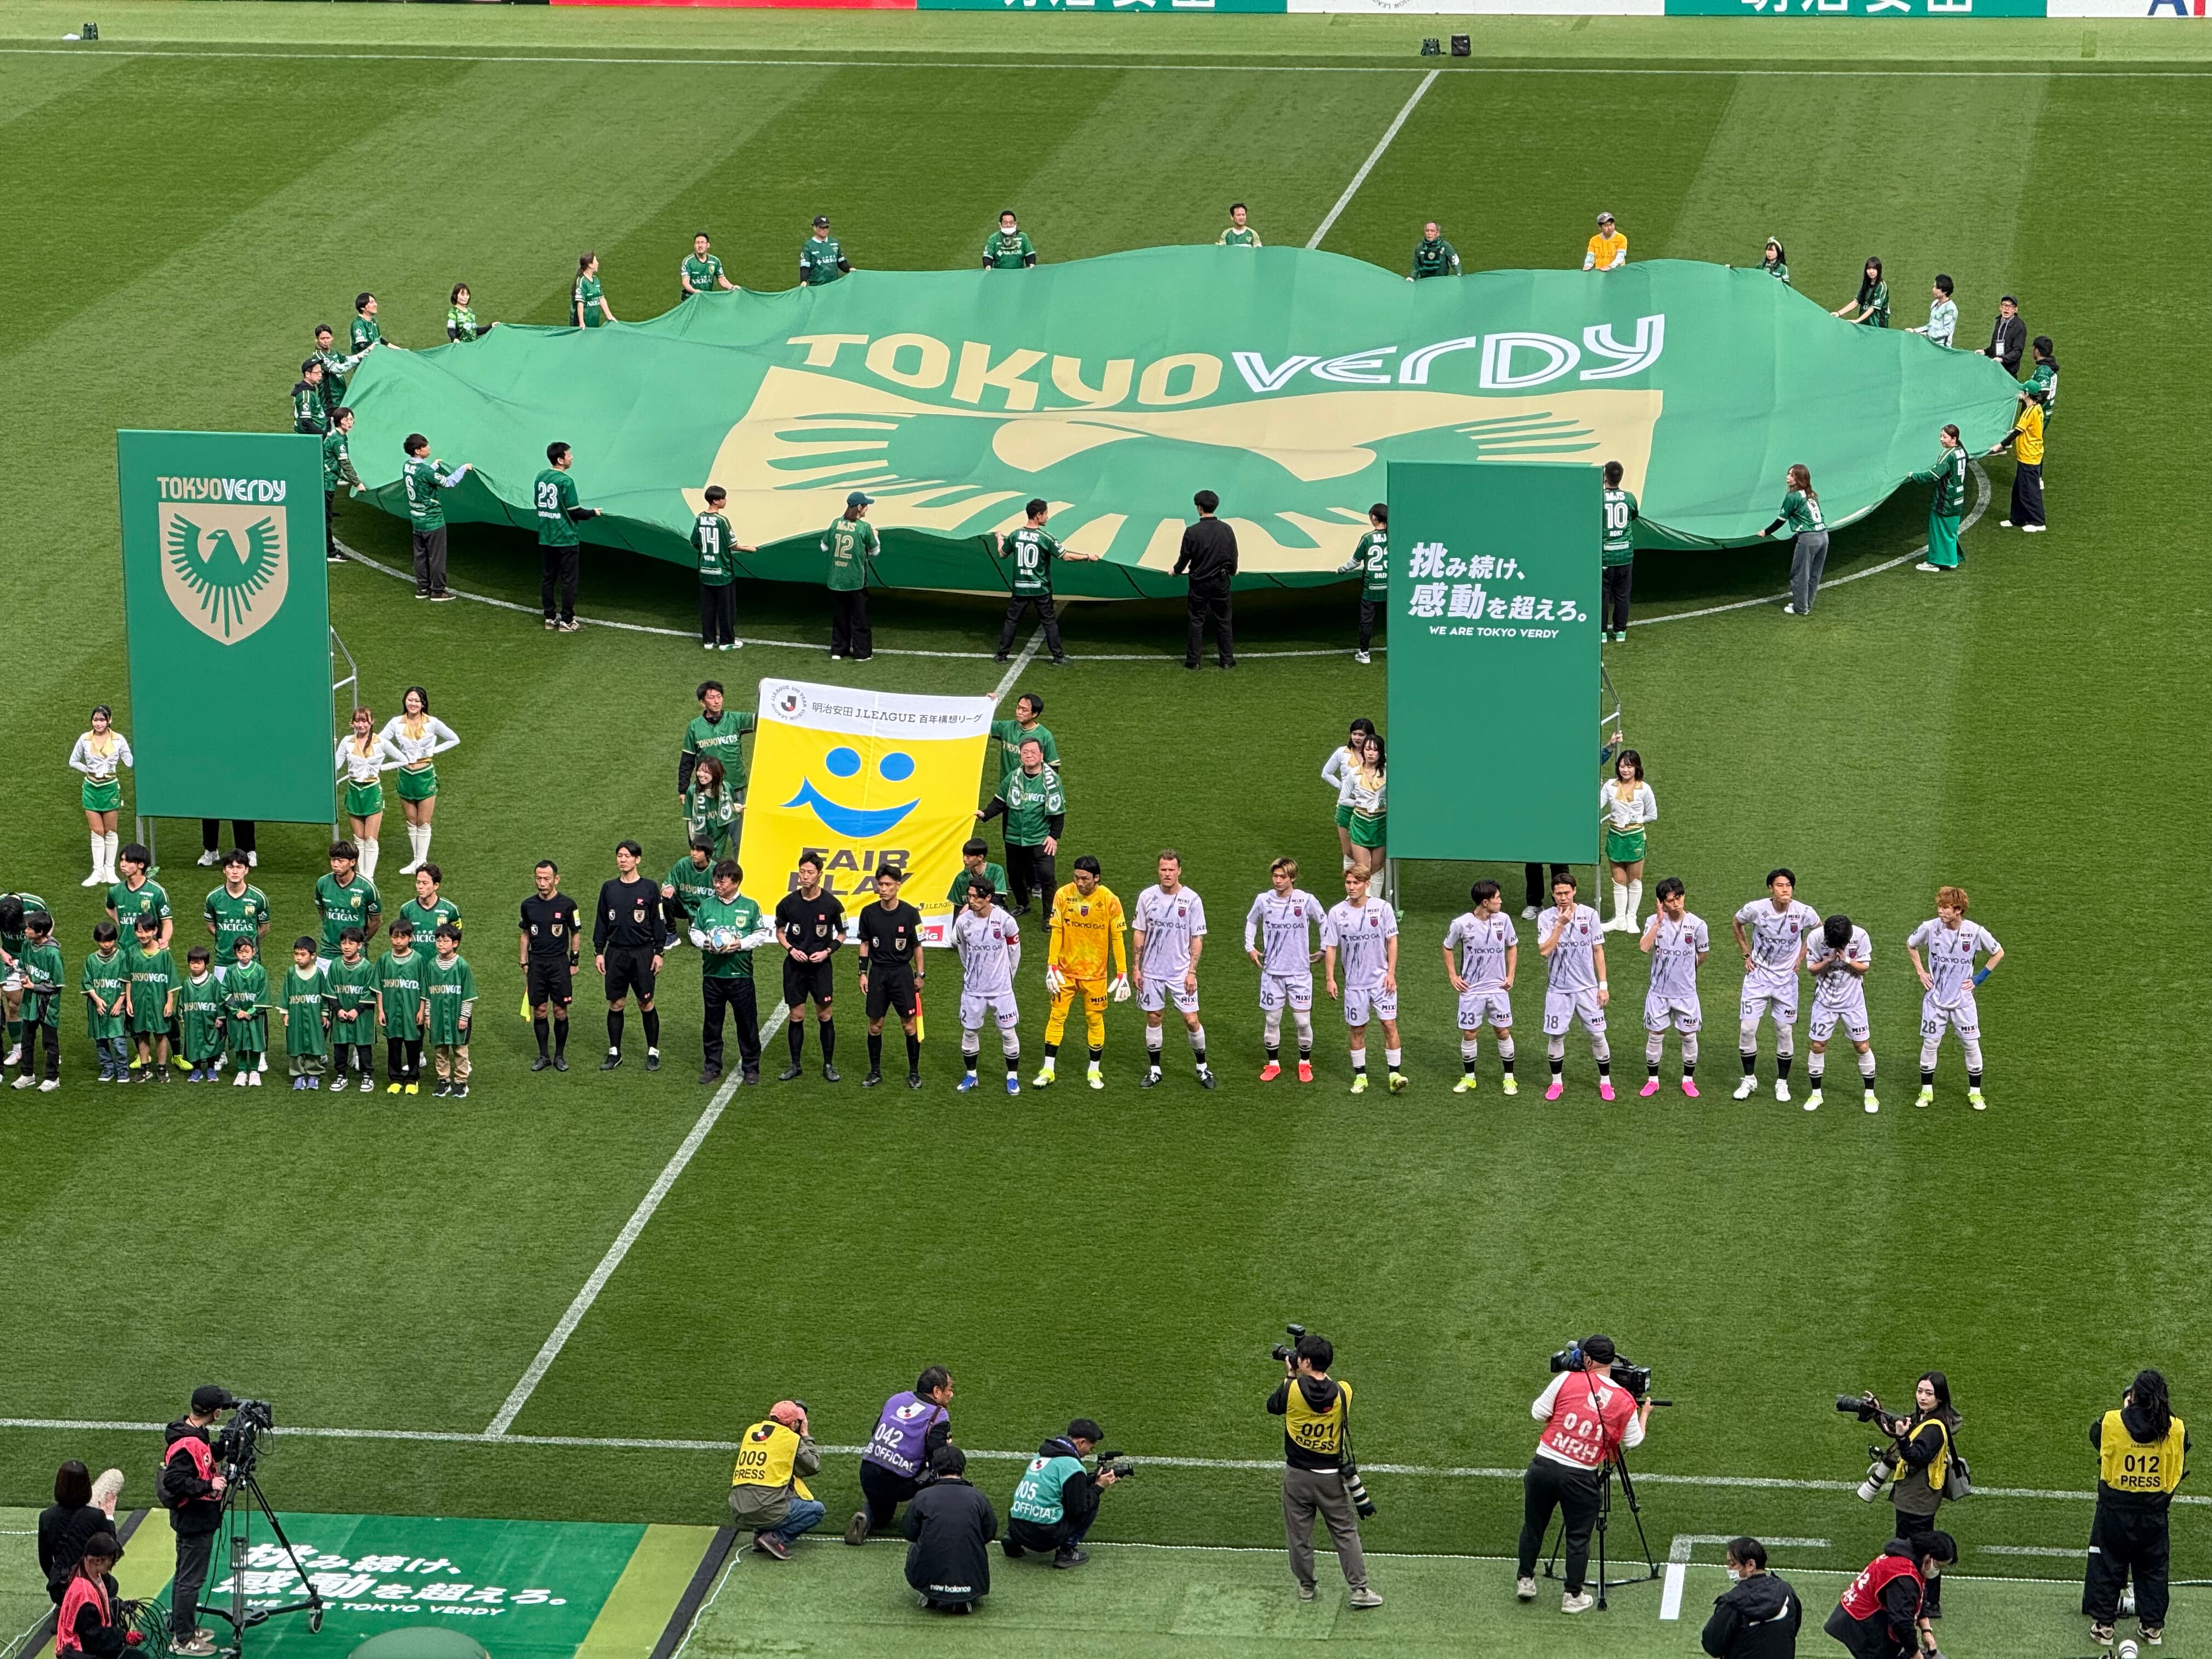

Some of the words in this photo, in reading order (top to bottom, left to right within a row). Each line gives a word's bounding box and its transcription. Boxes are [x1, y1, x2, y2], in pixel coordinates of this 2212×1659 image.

[157, 476, 286, 502] TOKYOVERDY
[538, 481, 558, 510] 23
[1605, 491, 1626, 502] MJS
[1605, 502, 1628, 529] 10
[836, 521, 857, 532] MJS
[699, 527, 719, 554] 14
[1018, 531, 1039, 542] MJS
[1372, 533, 1387, 543] MJ
[834, 533, 854, 559] 12
[1015, 542, 1039, 569] 10
[1409, 541, 1525, 580] 挑み続け、
[1408, 582, 1587, 622] 感動を超えろ。
[1429, 626, 1446, 635] WE
[1449, 627, 1474, 636] ARE
[1477, 627, 1517, 637] TOKYO
[1520, 628, 1559, 639] VERDY
[812, 702, 853, 717] 明治安田
[855, 707, 916, 723] J.LEAGUE
[919, 713, 983, 724] 百年構想リーグ
[218, 923, 253, 931] NICIGAS
[1764, 937, 1787, 945] TOKYO
[1660, 948, 1682, 956] TOKYO
[1091, 995, 1107, 1003] MIXI
[1261, 991, 1274, 1006] 26
[1346, 1006, 1358, 1021] 16
[1741, 1001, 1752, 1014] 15
[961, 1009, 967, 1023] 2
[1460, 1011, 1475, 1025] 23
[1546, 1014, 1559, 1029] 18
[1592, 1016, 1604, 1024] MIX
[1810, 1022, 1826, 1037] 42
[1922, 1020, 1937, 1035] 28
[874, 1423, 904, 1449] 042
[1301, 1422, 1335, 1438] 001
[738, 1450, 767, 1467] 009
[874, 1445, 915, 1473] OFFICIAL
[2124, 1454, 2160, 1474] 012
[734, 1468, 766, 1480] PRESS
[2120, 1475, 2161, 1488] PRESS
[1013, 1501, 1057, 1520] OFFICIAL
[930, 1584, 945, 1592] new
[944, 1584, 972, 1593] balance
[247, 1599, 282, 1608] WE
[343, 1602, 421, 1613] TOKYO
[429, 1605, 506, 1616] VERDY
